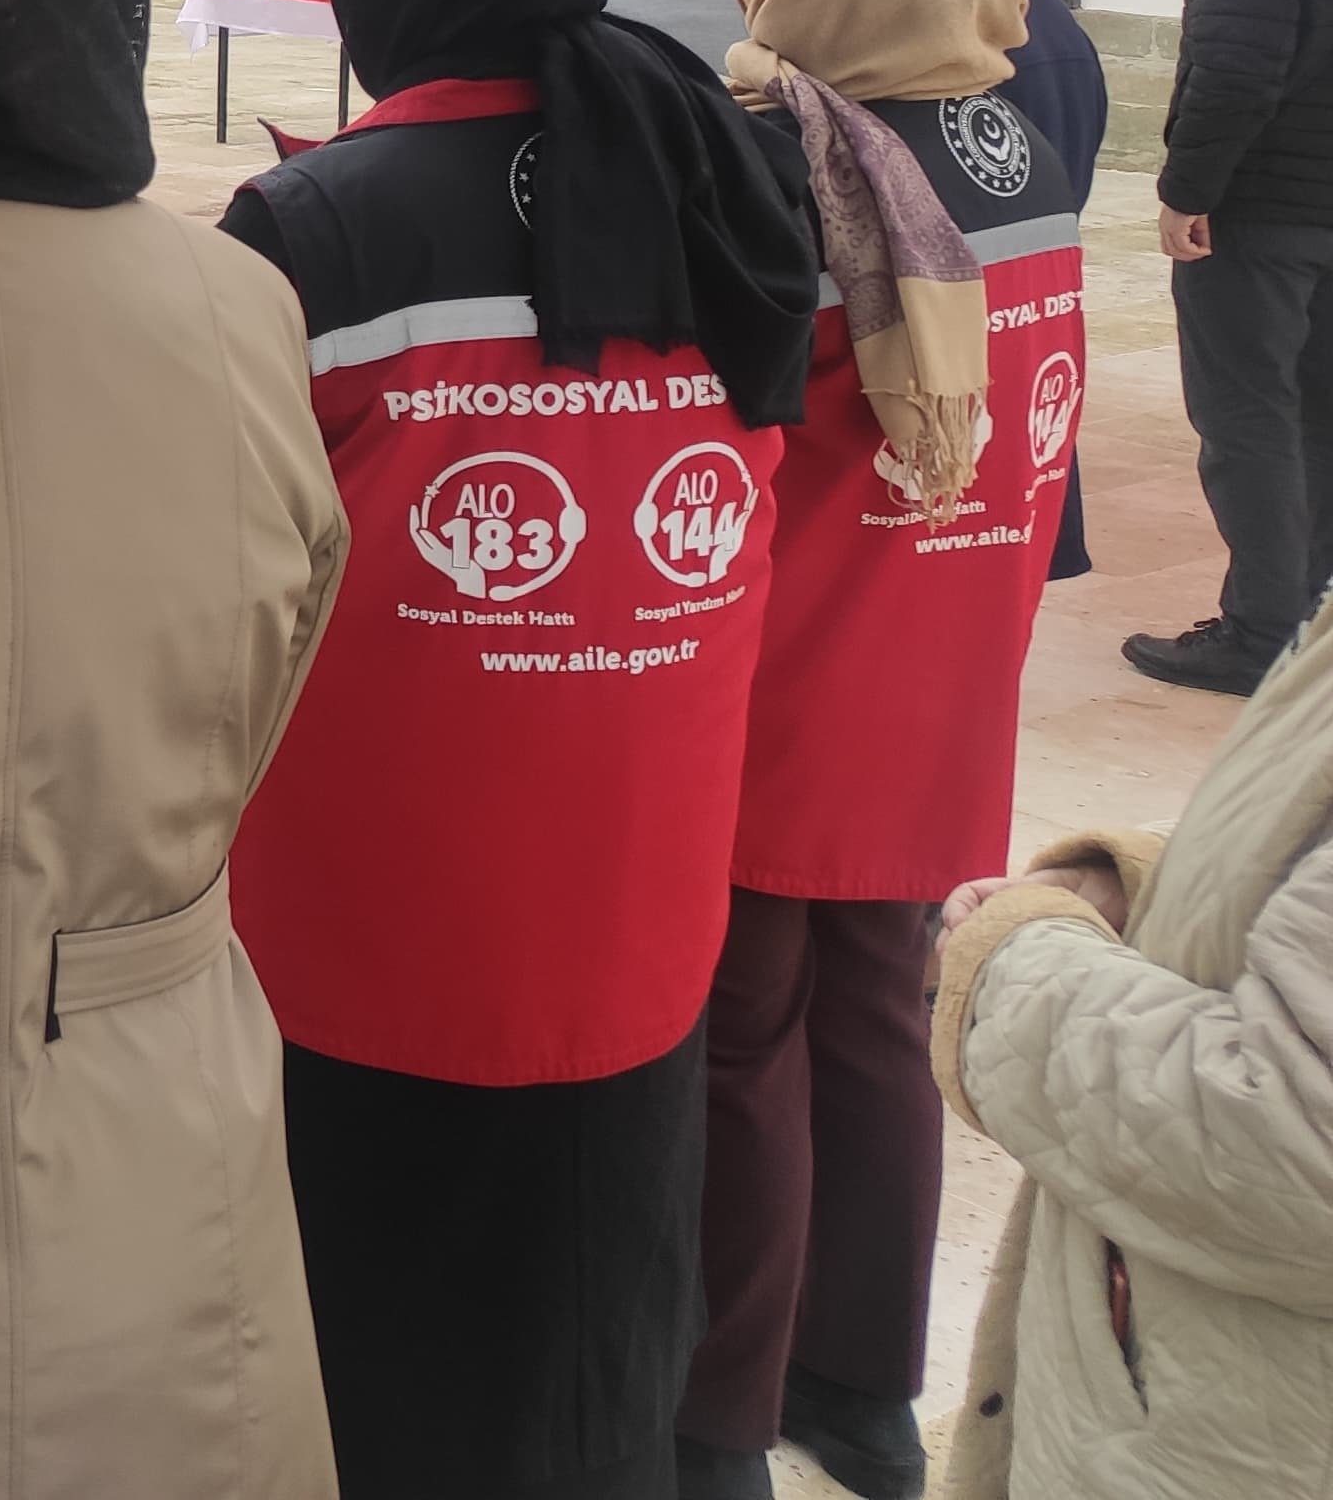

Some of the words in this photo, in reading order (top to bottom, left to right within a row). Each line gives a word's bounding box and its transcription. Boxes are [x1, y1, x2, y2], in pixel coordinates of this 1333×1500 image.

[985, 301, 1041, 333] SYAL
[383, 379, 658, 422] PSİKOSOSYAL
[455, 483, 516, 519] ALO
[673, 469, 719, 507] ALO
[660, 502, 738, 561] 144
[860, 511, 910, 529] Sosyal
[439, 517, 554, 571] 183
[397, 603, 458, 625] Sosyal
[462, 610, 525, 626] Destek
[529, 610, 575, 626] Hattı
[635, 603, 681, 622] Sosyal
[480, 637, 700, 675] www.aile.gov.tr
